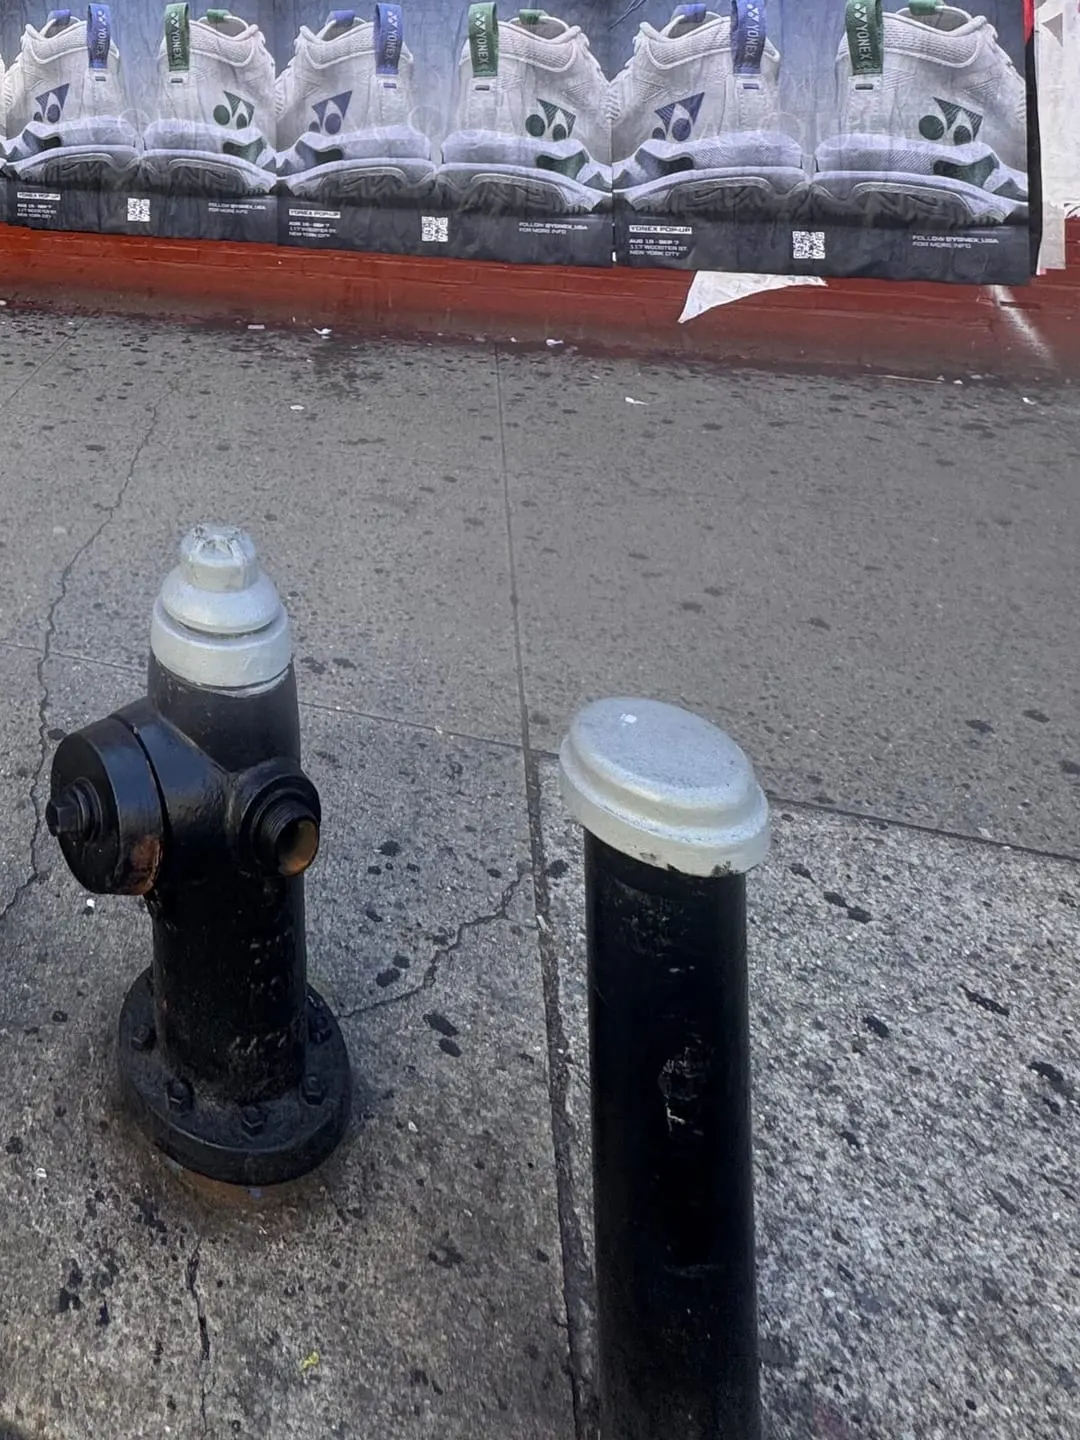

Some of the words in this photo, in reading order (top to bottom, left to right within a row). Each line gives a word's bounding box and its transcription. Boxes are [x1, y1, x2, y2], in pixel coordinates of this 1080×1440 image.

[385, 31, 397, 59] YONEX
[476, 34, 489, 64] YONEX
[744, 24, 759, 57] YONEX
[855, 25, 872, 60] YONEX
